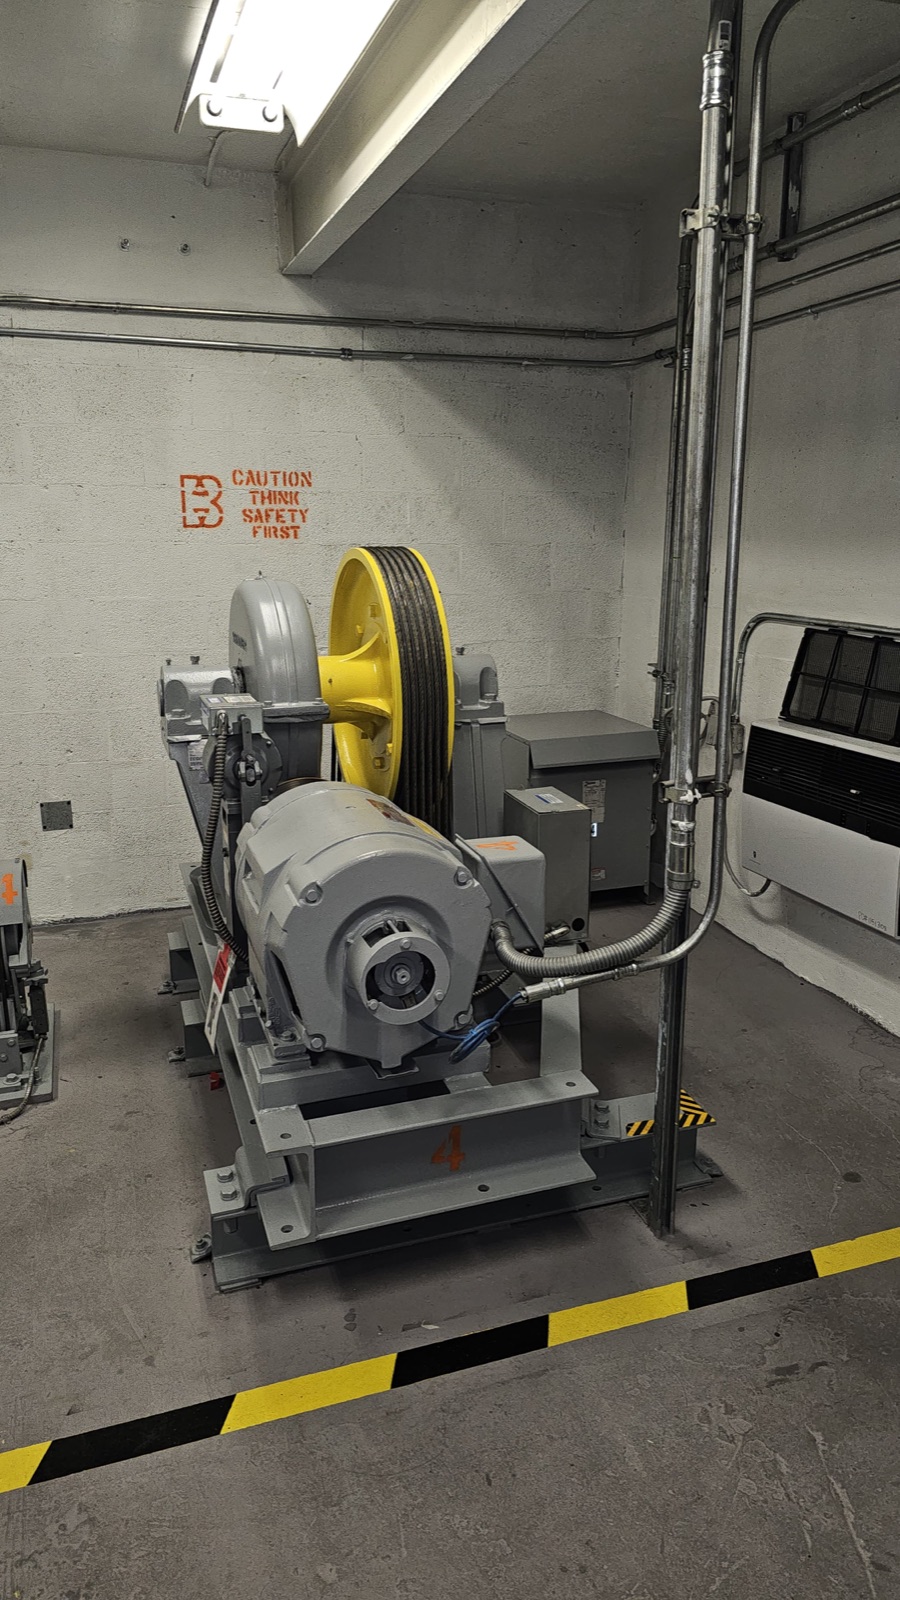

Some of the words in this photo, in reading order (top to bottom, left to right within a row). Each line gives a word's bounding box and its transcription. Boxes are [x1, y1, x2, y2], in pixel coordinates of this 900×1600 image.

[231, 469, 313, 488] CAUTION
[249, 490, 300, 506] THINK
[241, 508, 310, 524] SAFETY
[252, 525, 301, 540] FIRST
[431, 1124, 466, 1172] 4
